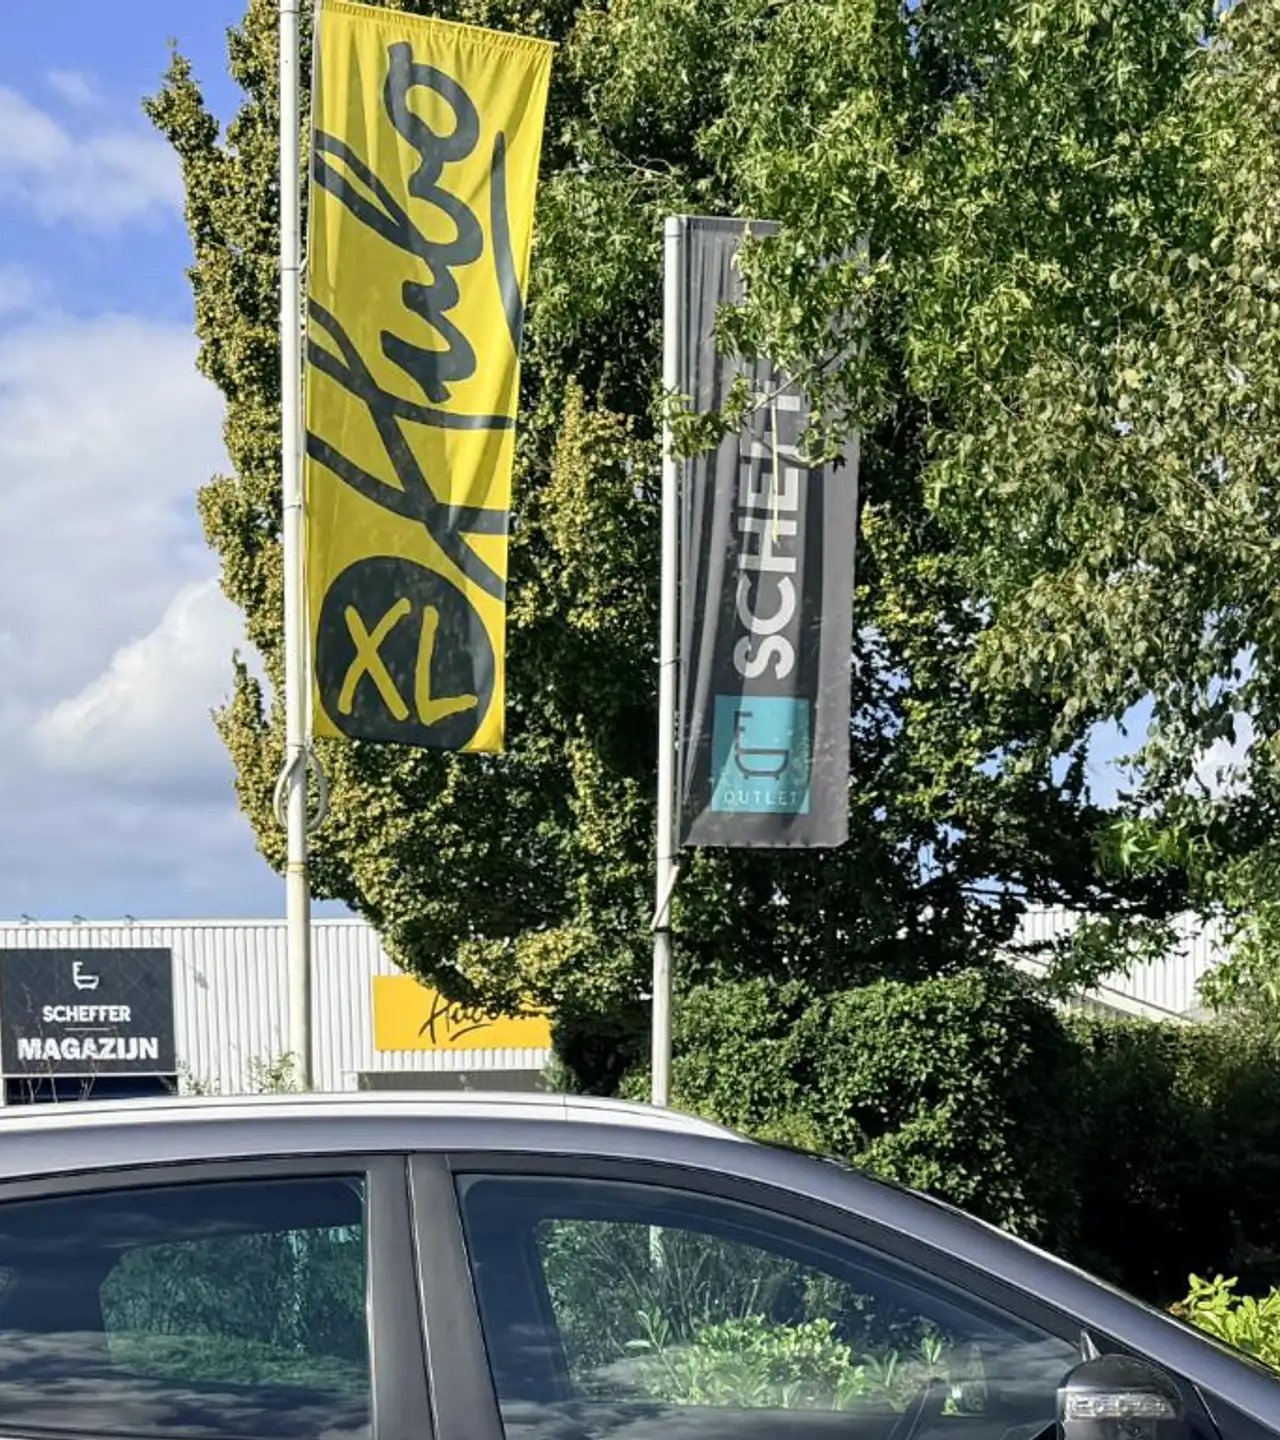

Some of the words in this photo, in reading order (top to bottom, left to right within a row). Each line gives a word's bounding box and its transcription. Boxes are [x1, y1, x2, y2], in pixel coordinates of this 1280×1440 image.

[307, 40, 520, 602] Hubo
[337, 597, 478, 726] XL
[724, 789, 797, 806] OUTLET
[42, 1005, 132, 1022] SCHEFFER
[17, 1037, 159, 1060] MAGAZIJN
